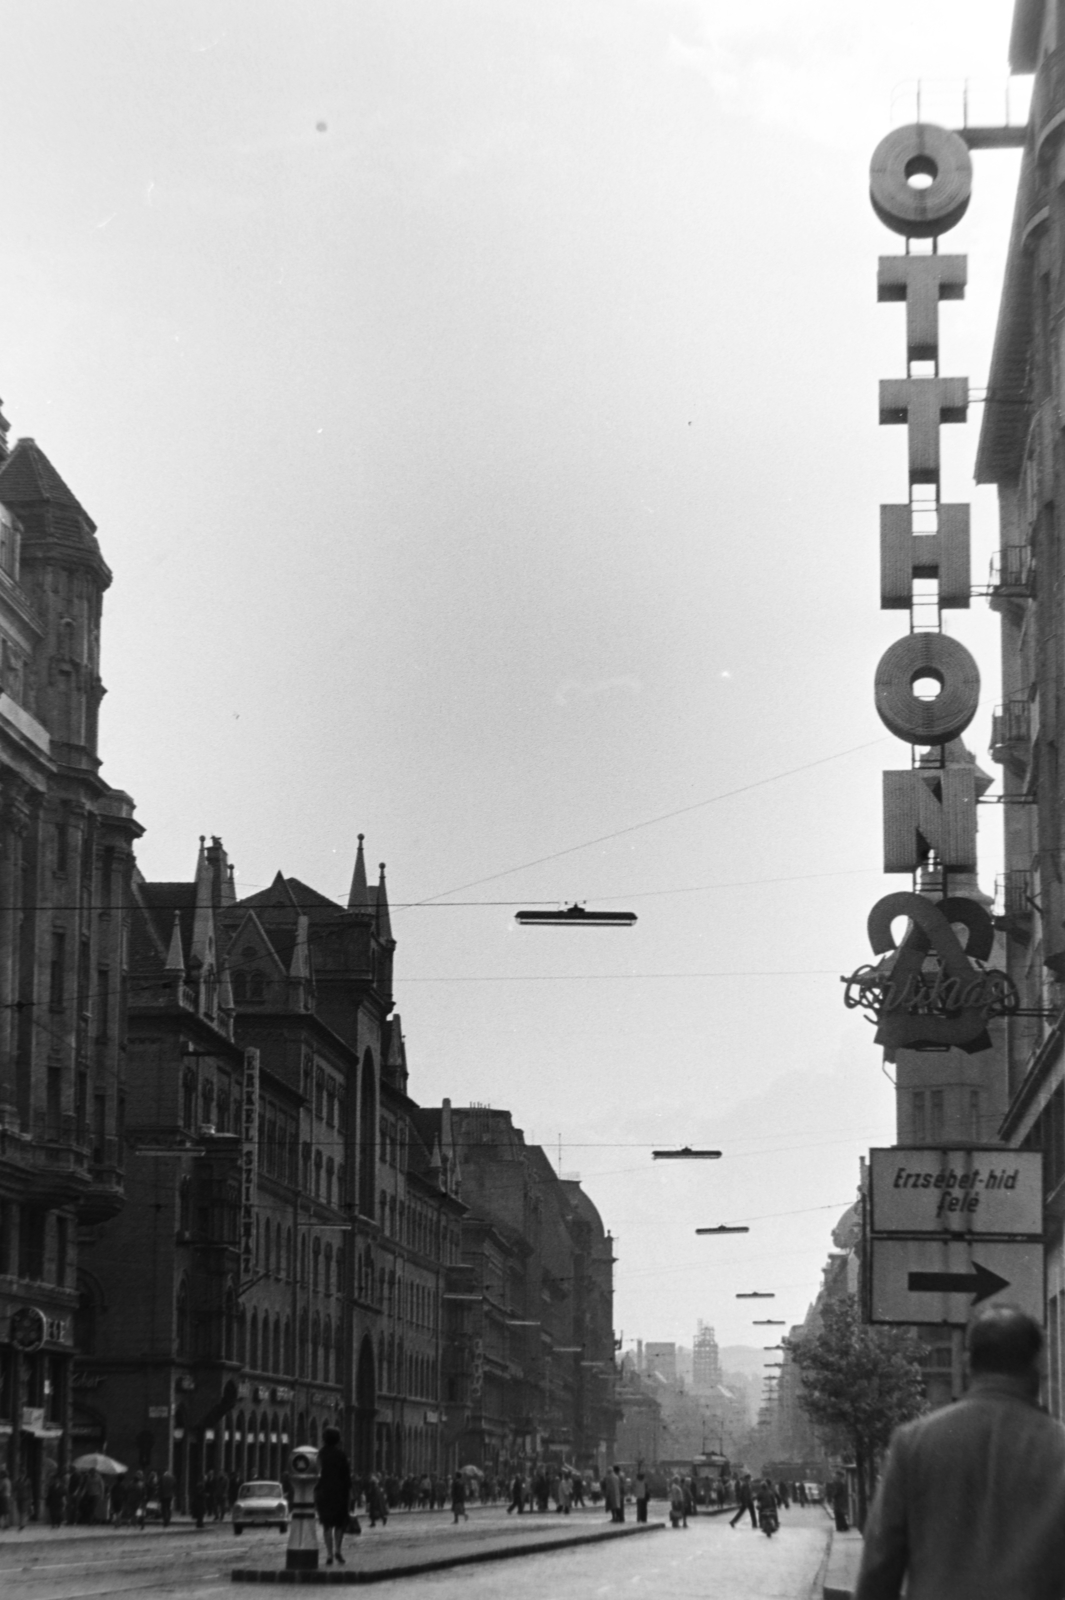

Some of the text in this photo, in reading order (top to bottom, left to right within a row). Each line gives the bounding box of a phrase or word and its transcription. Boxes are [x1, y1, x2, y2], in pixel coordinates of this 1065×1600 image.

[869, 122, 979, 873] OTTHON
[244, 1055, 255, 1141] ERKEL
[935, 1190, 980, 1218] felé
